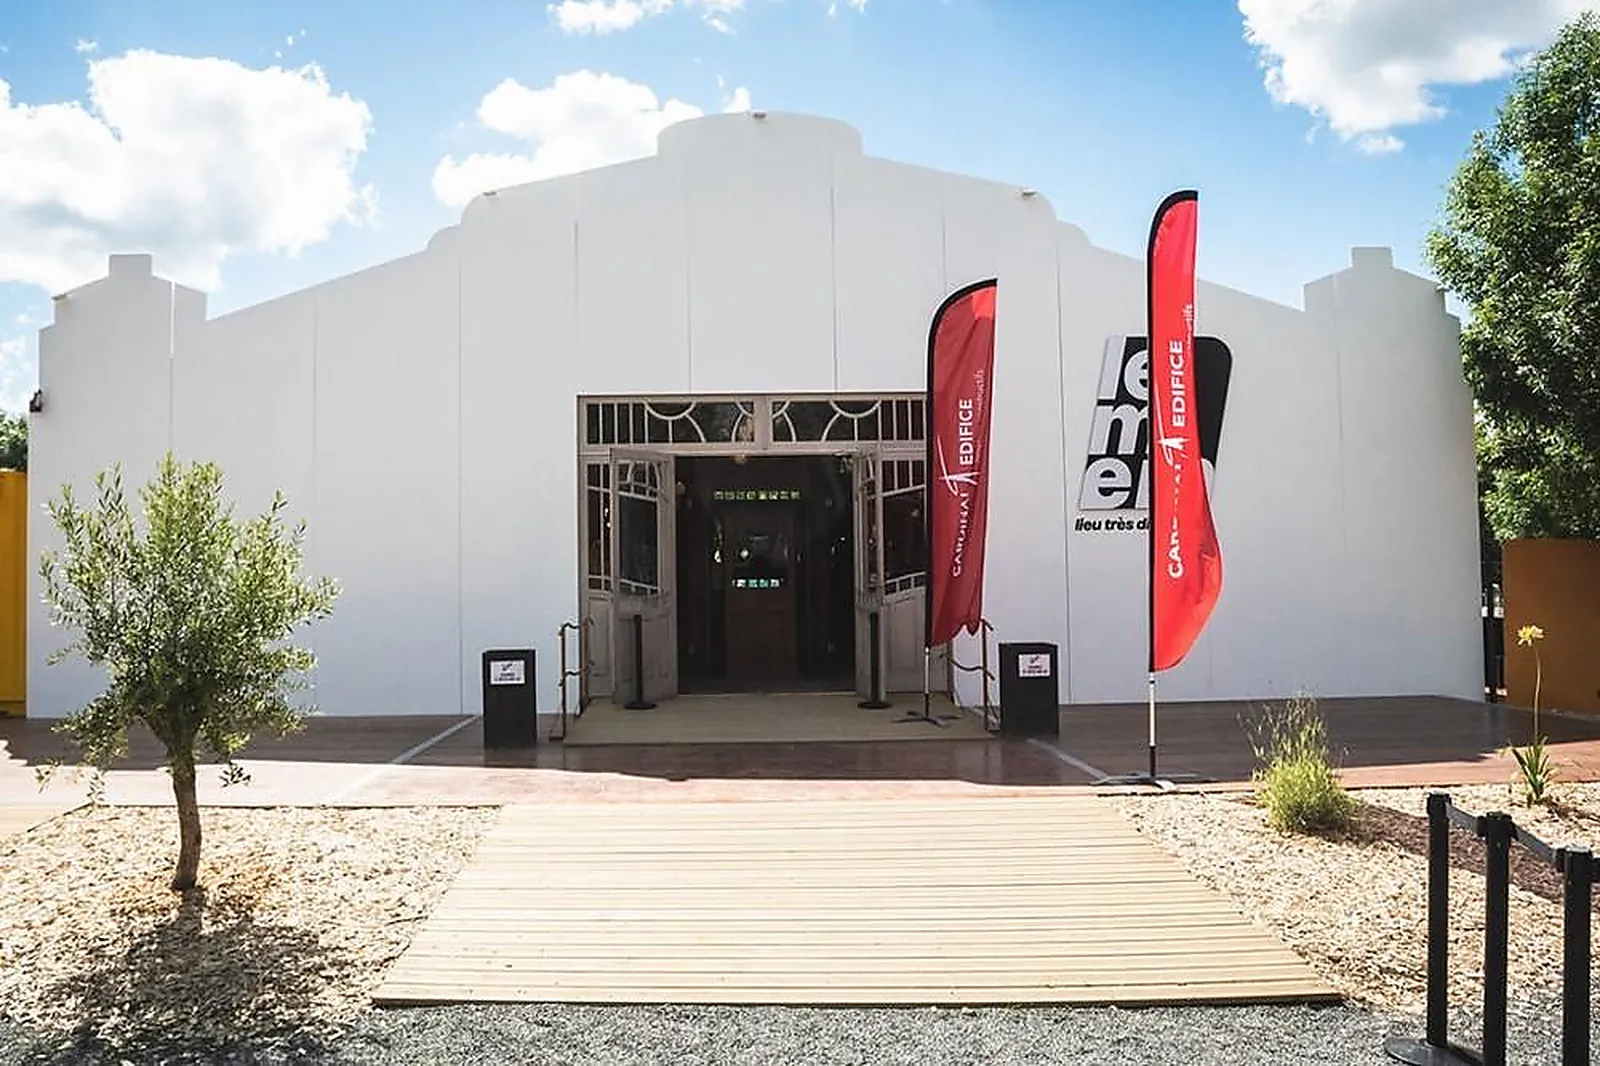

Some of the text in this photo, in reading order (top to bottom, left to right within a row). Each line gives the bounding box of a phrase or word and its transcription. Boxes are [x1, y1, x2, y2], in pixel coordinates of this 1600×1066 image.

[1169, 340, 1186, 428] EDIFICE
[958, 398, 974, 466] EDIFICE
[1074, 517, 1102, 532] lieu
[1104, 515, 1135, 531] très
